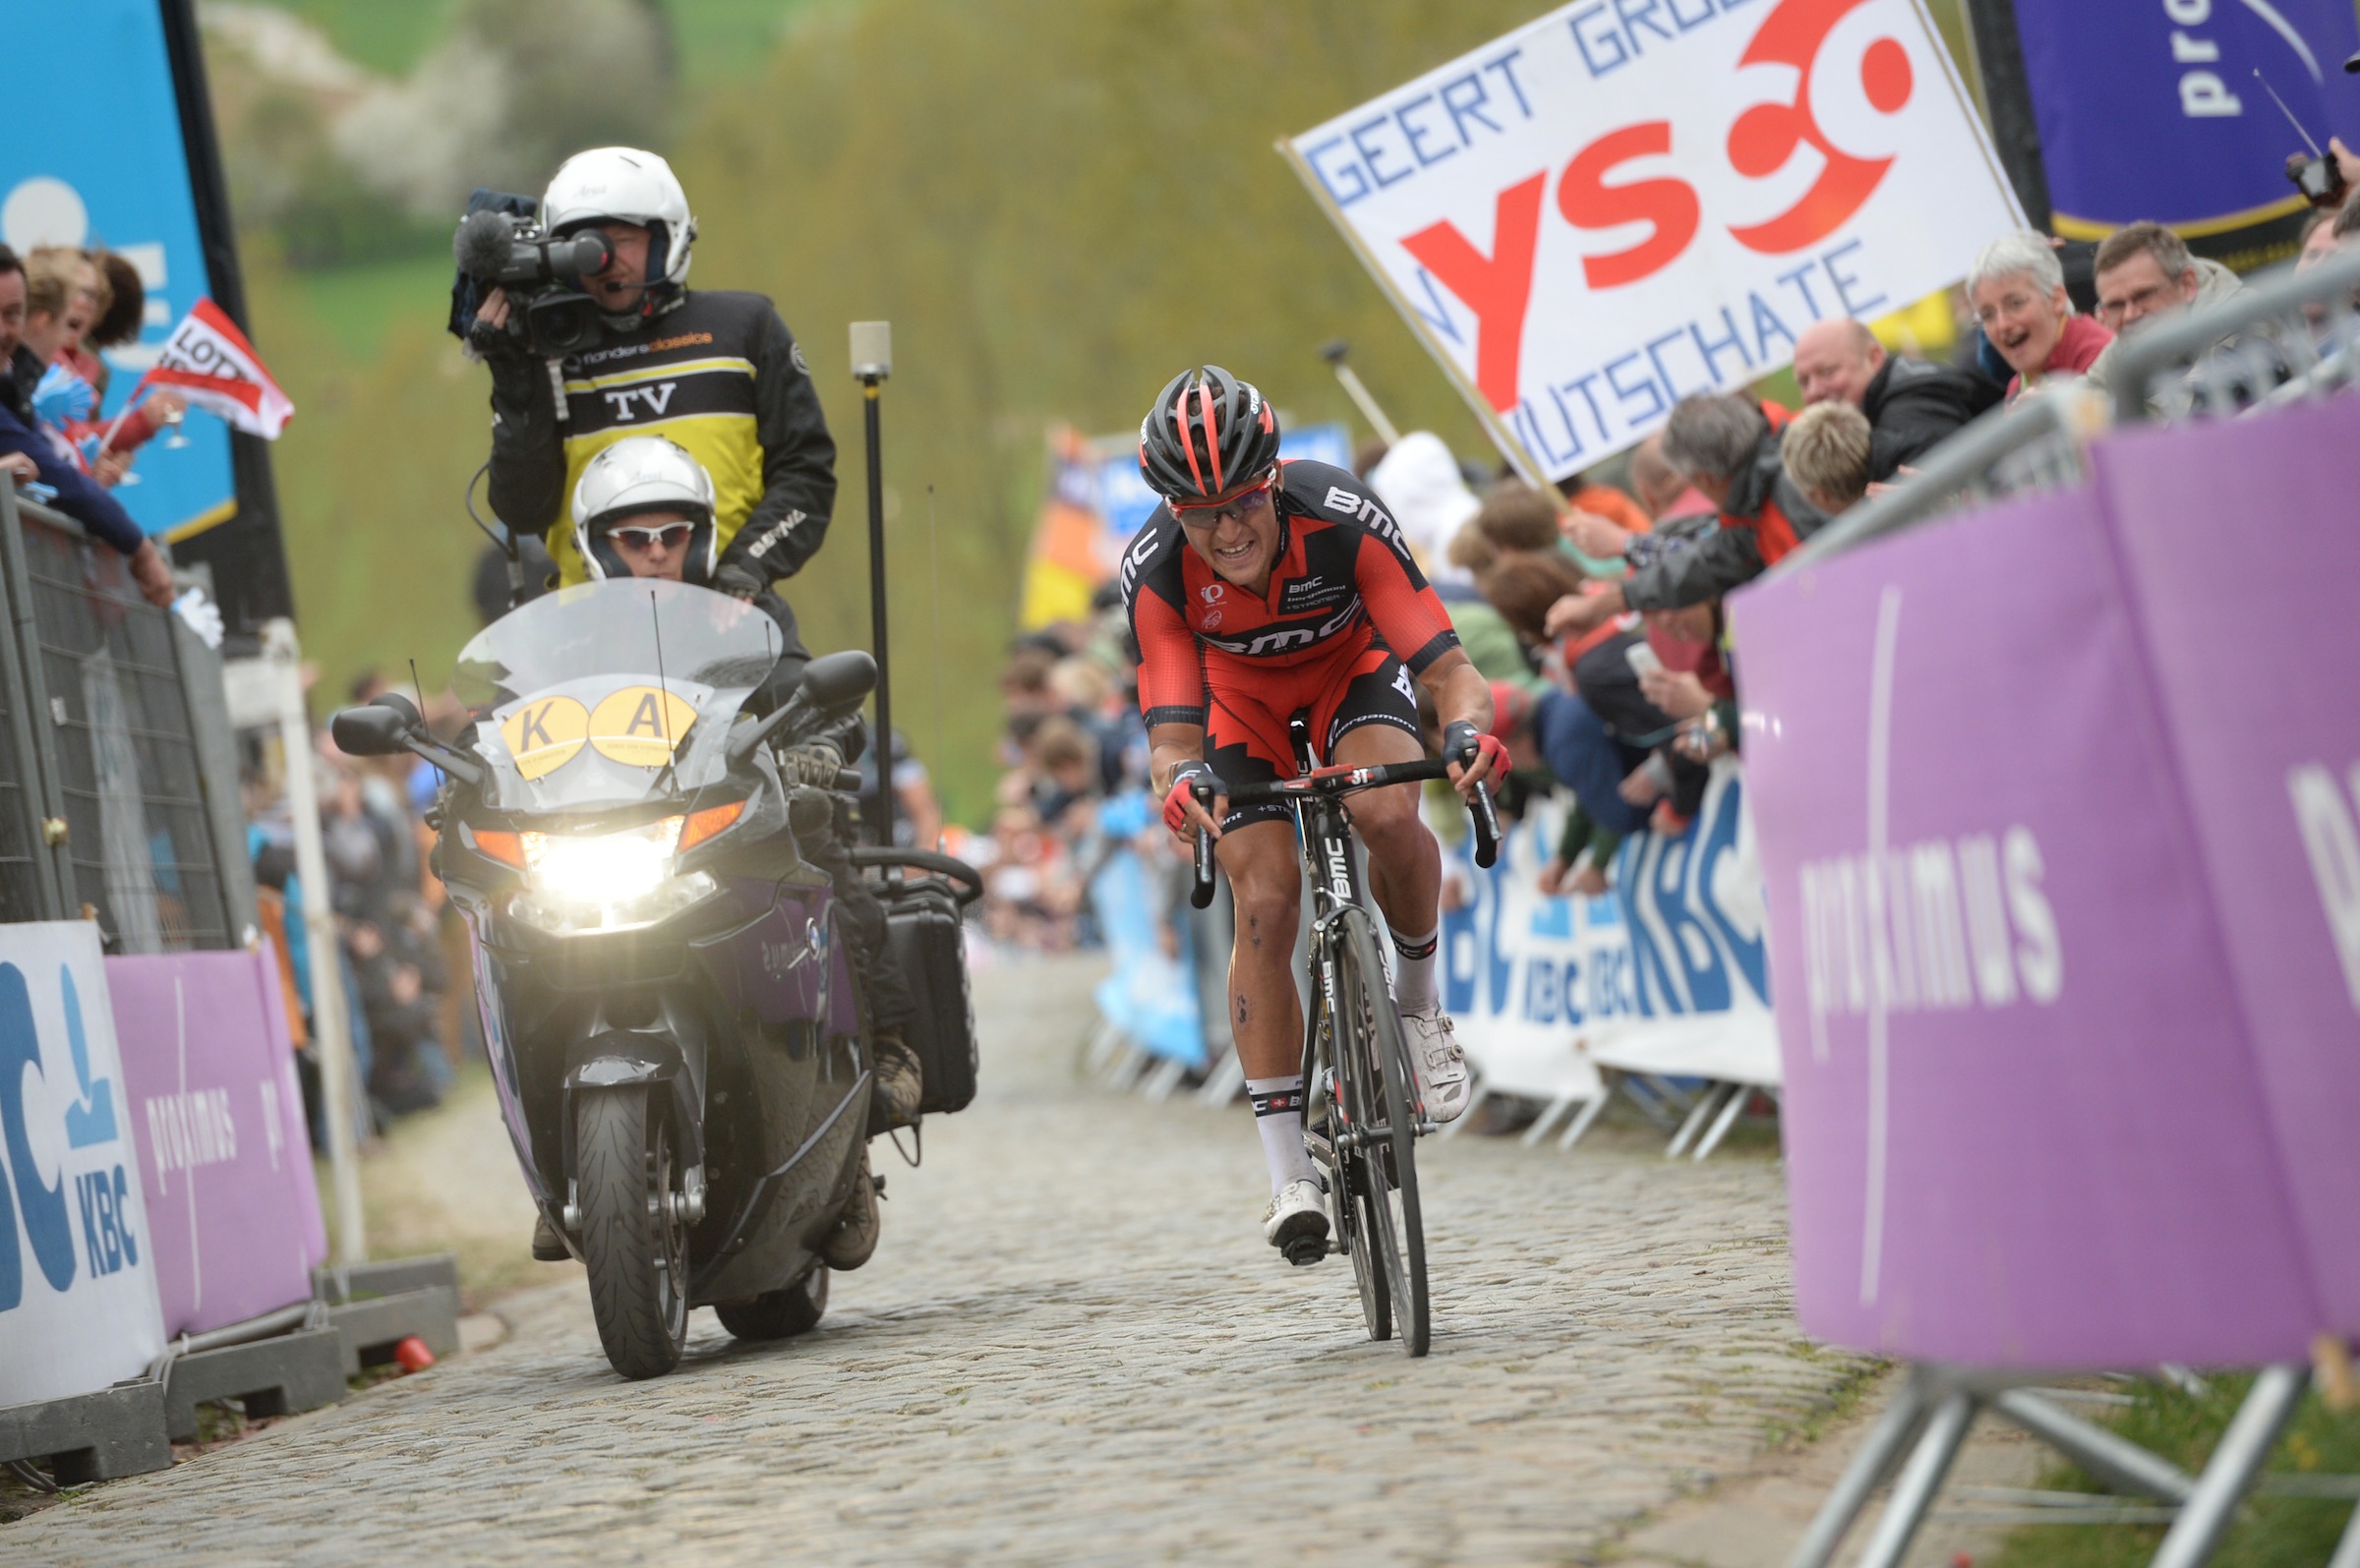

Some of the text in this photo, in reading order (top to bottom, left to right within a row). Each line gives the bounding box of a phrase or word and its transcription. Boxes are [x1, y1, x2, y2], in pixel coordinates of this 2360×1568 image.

[1305, 49, 1533, 208] GEERT
[605, 382, 677, 421] TV
[1323, 486, 1411, 561] BMC
[1121, 527, 1159, 621] MC
[1288, 575, 1324, 594] BMC
[1194, 592, 1362, 656] BMC
[520, 700, 555, 752] K
[625, 693, 664, 738] A
[1351, 768, 1369, 785] 3T
[1324, 838, 1352, 899] BMC
[1322, 960, 1335, 1014] BMC
[145, 1086, 238, 1196] proximus
[76, 1163, 139, 1279] KBC
